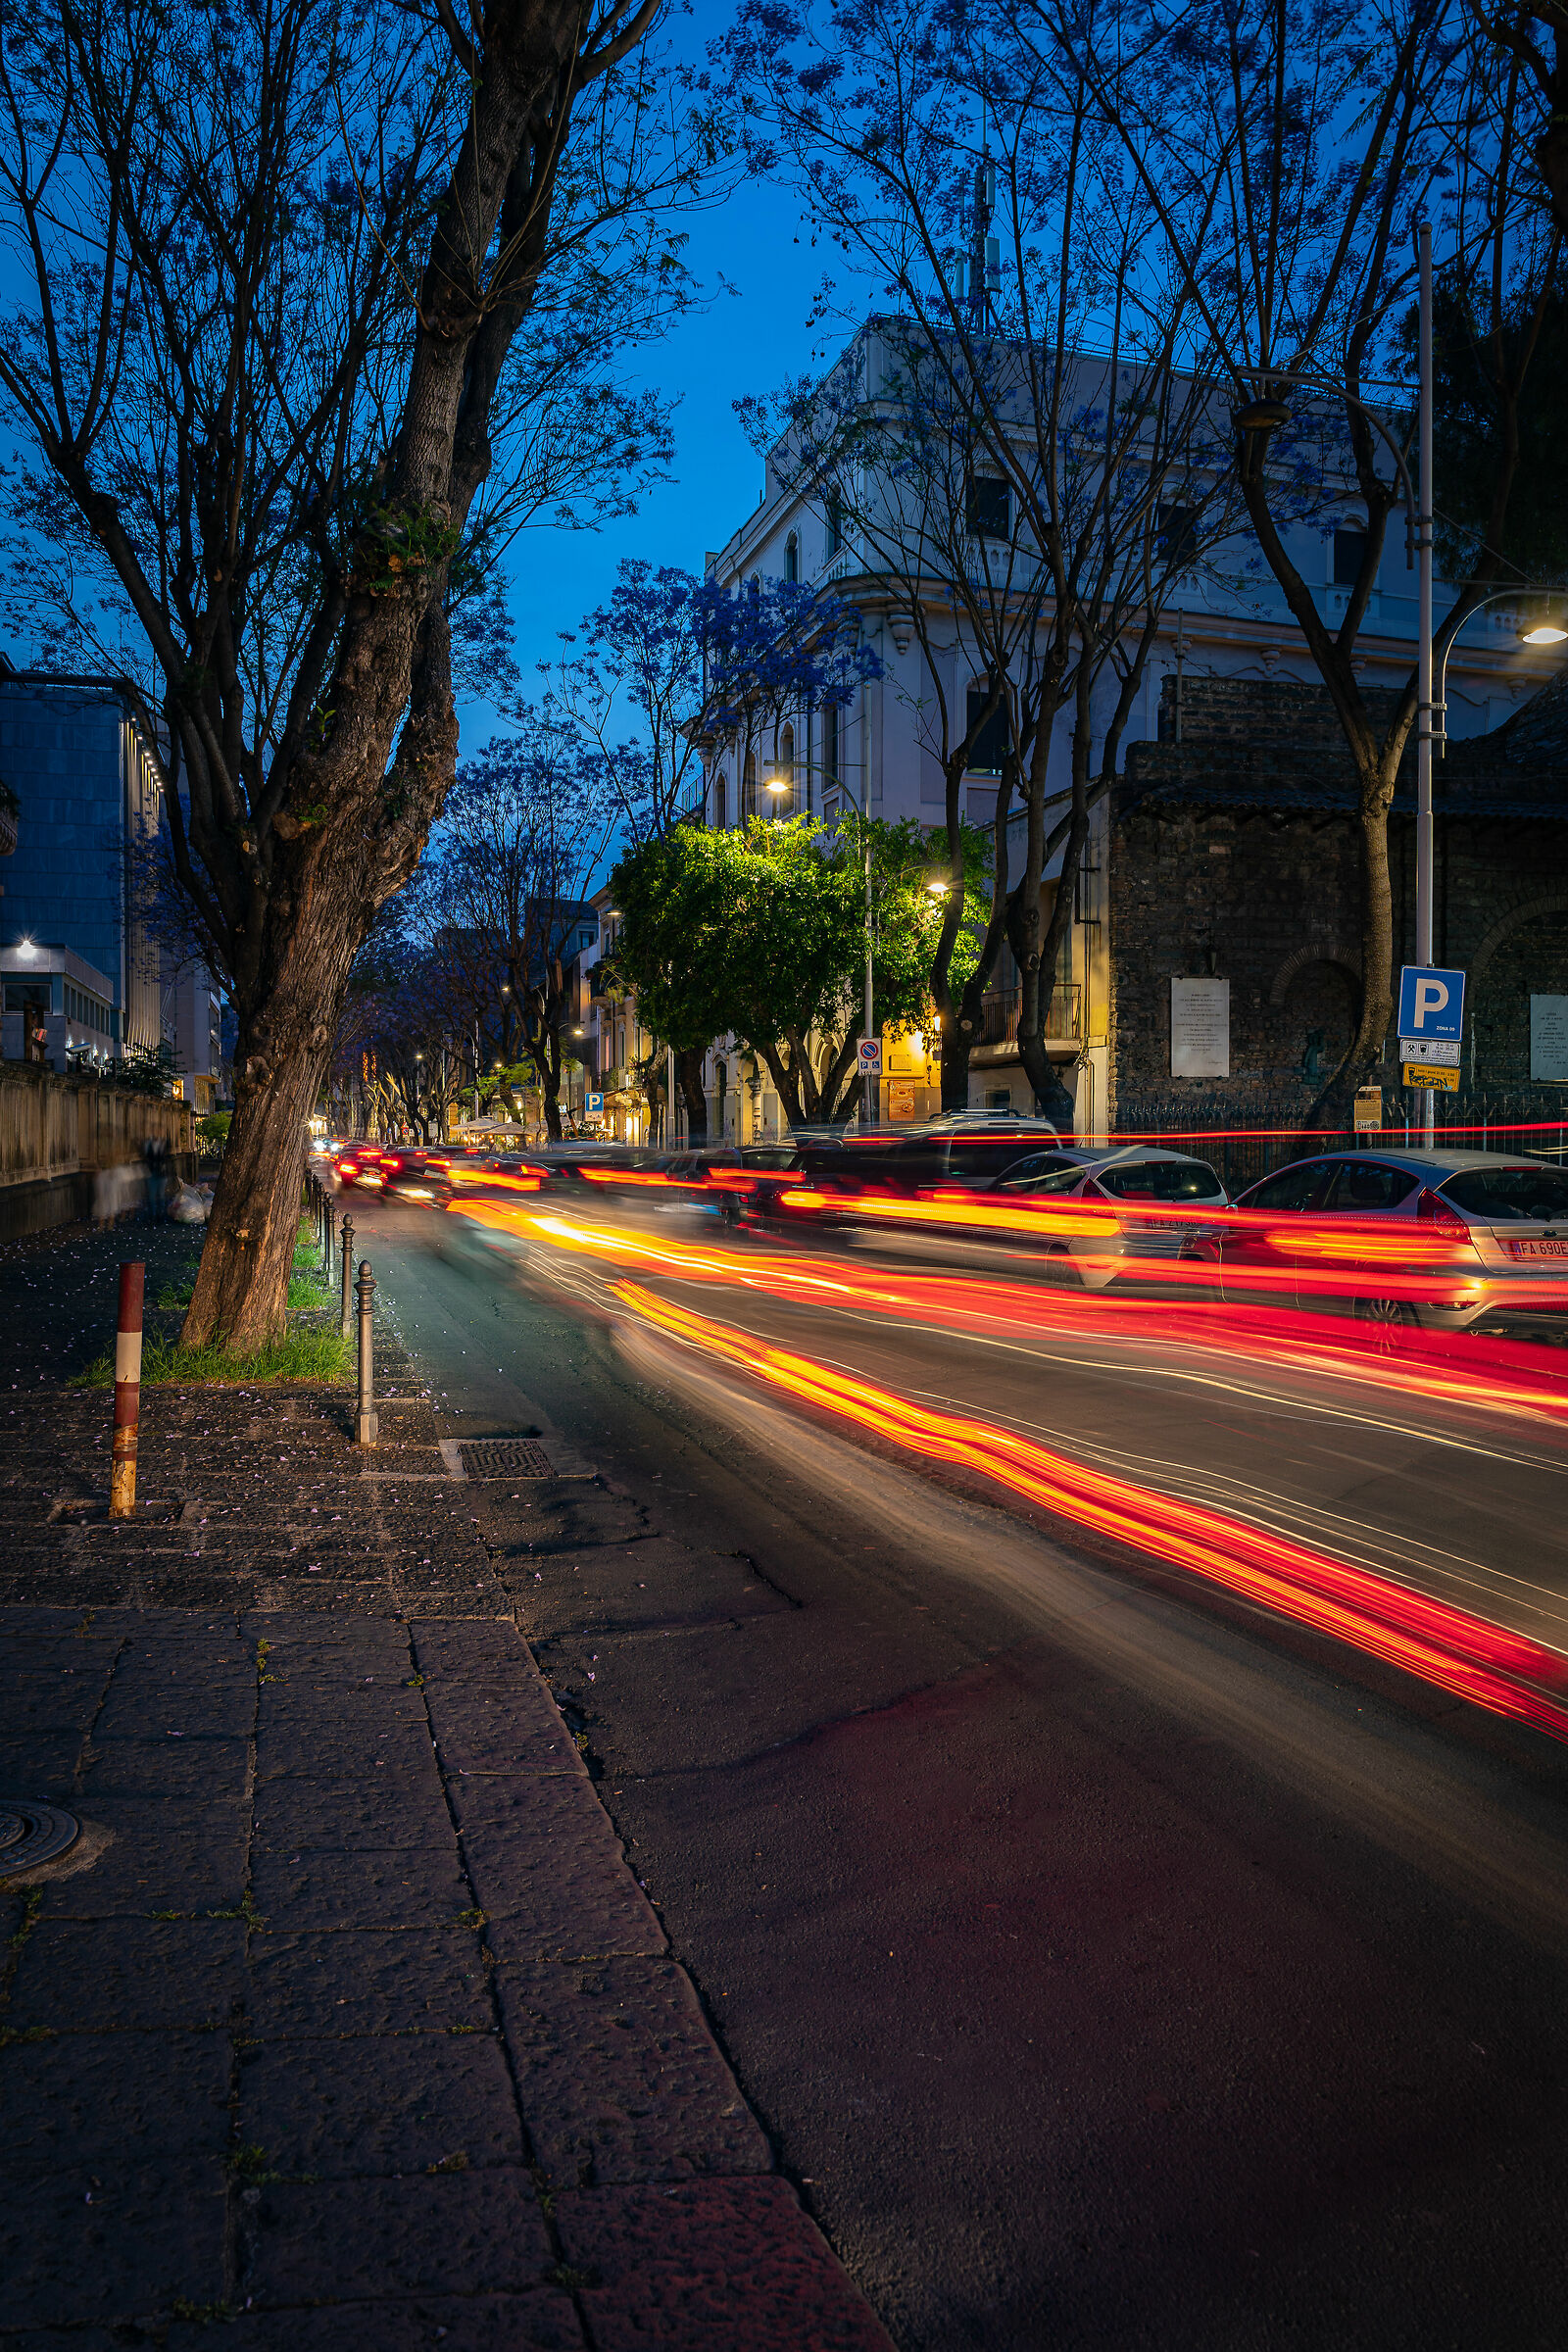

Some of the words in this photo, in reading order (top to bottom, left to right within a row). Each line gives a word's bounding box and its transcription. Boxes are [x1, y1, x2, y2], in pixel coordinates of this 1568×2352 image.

[1414, 978, 1448, 1028] P
[589, 1095, 600, 1109] P
[1521, 1242, 1537, 1254] FA
[1539, 1242, 1568, 1254] 690E
